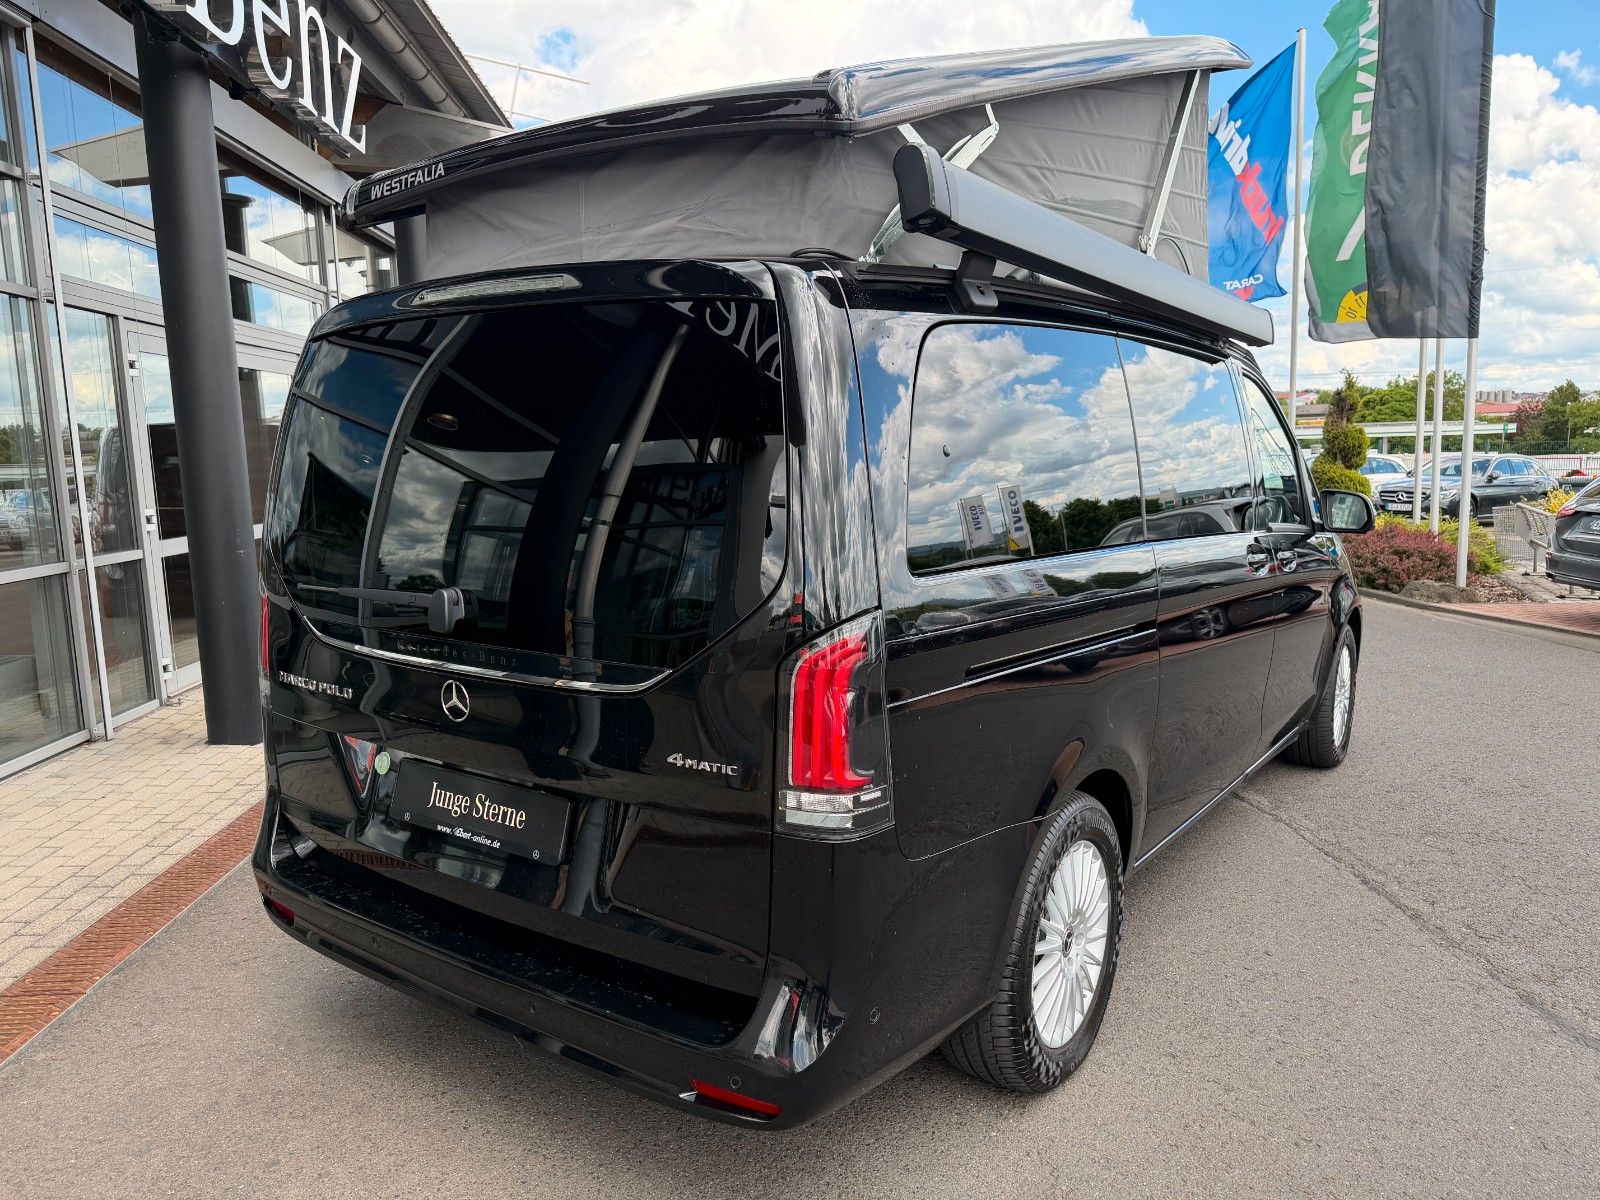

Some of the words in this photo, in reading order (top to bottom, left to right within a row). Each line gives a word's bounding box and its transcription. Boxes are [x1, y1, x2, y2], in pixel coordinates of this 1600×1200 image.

[371, 162, 445, 200] WESTFALIA
[969, 505, 983, 531] IVECO
[1008, 490, 1024, 532] IVECO
[319, 681, 354, 700] POLO
[666, 752, 738, 776] 4MATIC
[427, 781, 470, 817] Junge
[473, 793, 527, 829] Sterne
